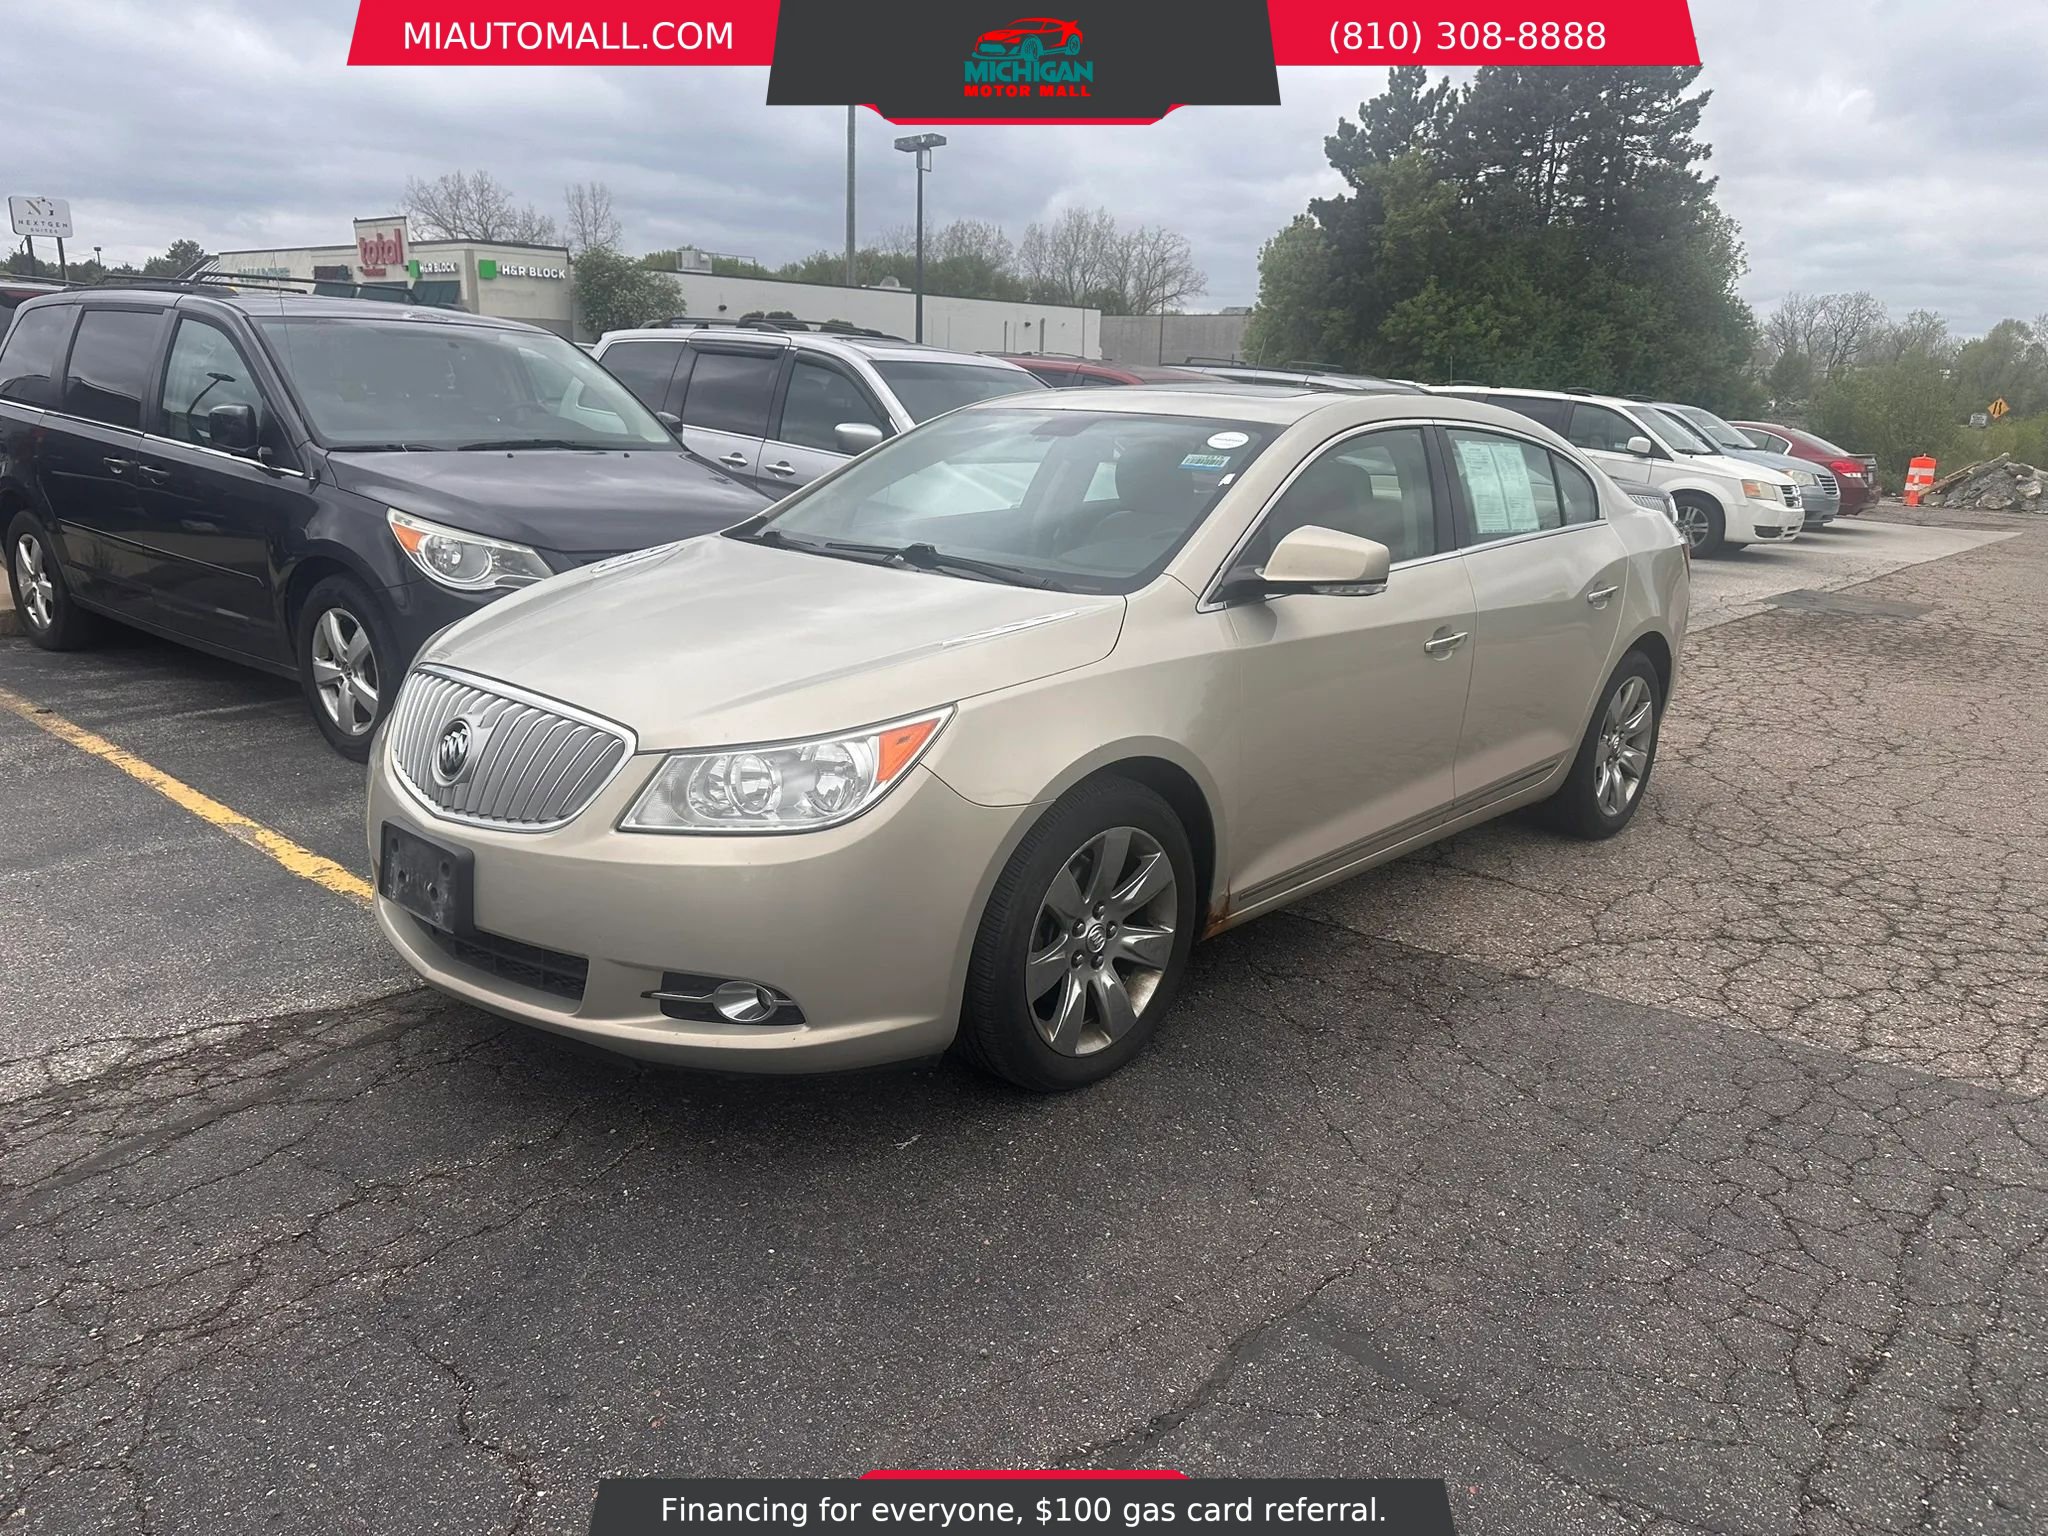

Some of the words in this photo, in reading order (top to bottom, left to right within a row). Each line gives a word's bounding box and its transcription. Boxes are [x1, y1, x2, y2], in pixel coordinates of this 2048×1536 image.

[17, 219, 68, 228] NEXTGEN
[359, 228, 404, 266] total
[419, 262, 434, 273] H&R
[434, 261, 456, 273] BLOCK
[501, 264, 526, 276] H&R
[528, 266, 566, 279] BLOCK
